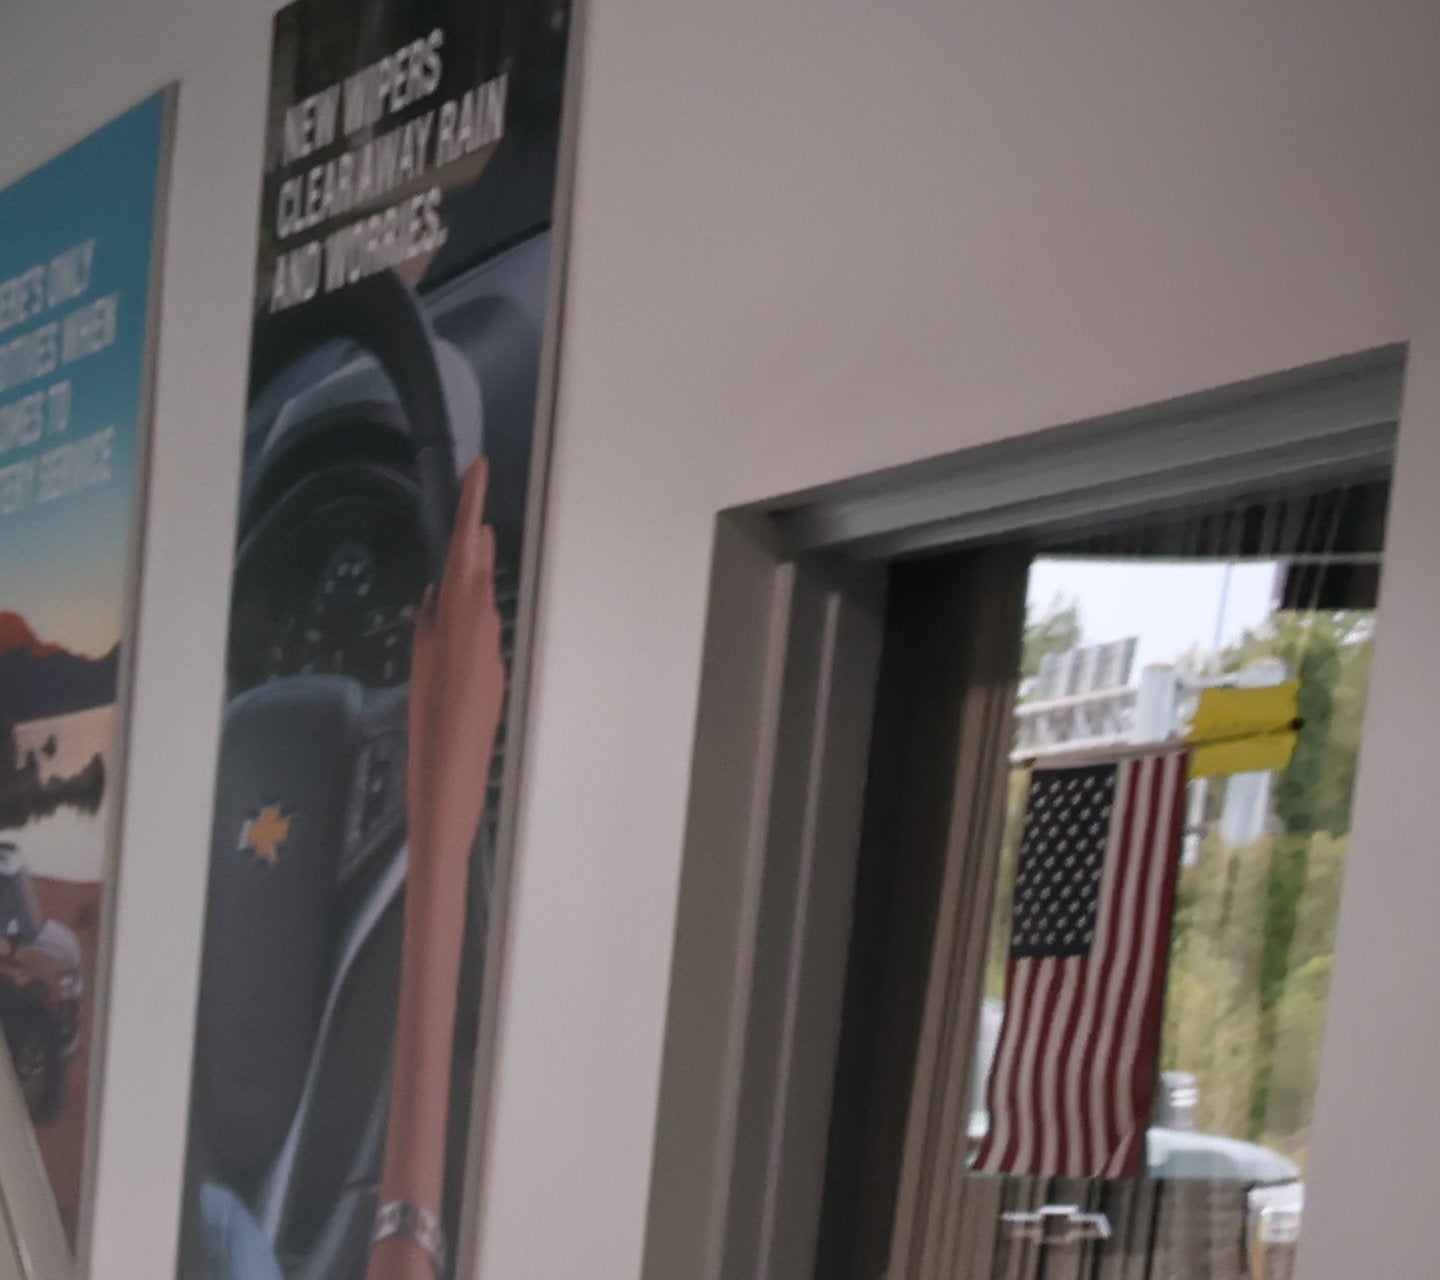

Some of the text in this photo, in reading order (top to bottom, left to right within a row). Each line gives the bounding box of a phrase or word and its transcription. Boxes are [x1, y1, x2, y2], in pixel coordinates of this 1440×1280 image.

[283, 27, 444, 167] NEW WIPERS
[435, 72, 508, 168] RAIN
